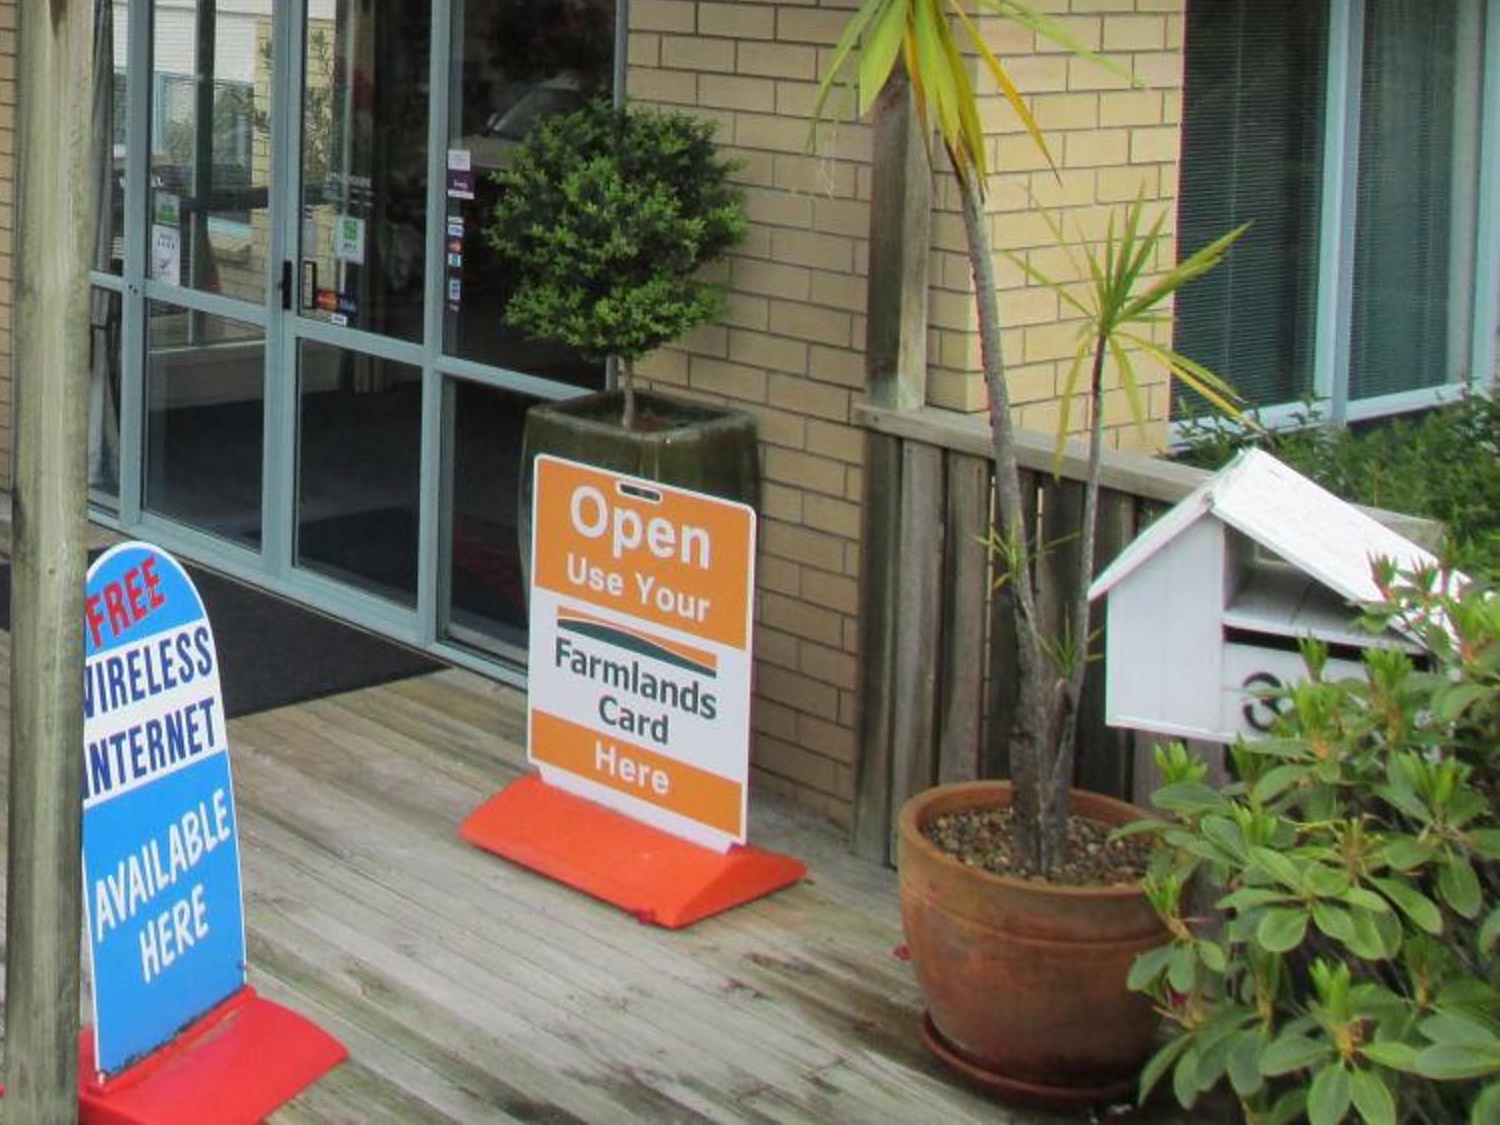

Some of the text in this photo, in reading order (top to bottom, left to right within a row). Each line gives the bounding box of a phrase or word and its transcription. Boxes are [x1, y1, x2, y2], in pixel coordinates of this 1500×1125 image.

[570, 485, 710, 570] Open
[85, 556, 166, 649] FREE
[566, 553, 709, 622] Use Your
[555, 638, 717, 721] Farmlands
[599, 697, 669, 745] Card
[595, 741, 669, 795] Here
[95, 789, 231, 943] AVAILABLE
[139, 884, 208, 983] HERE
